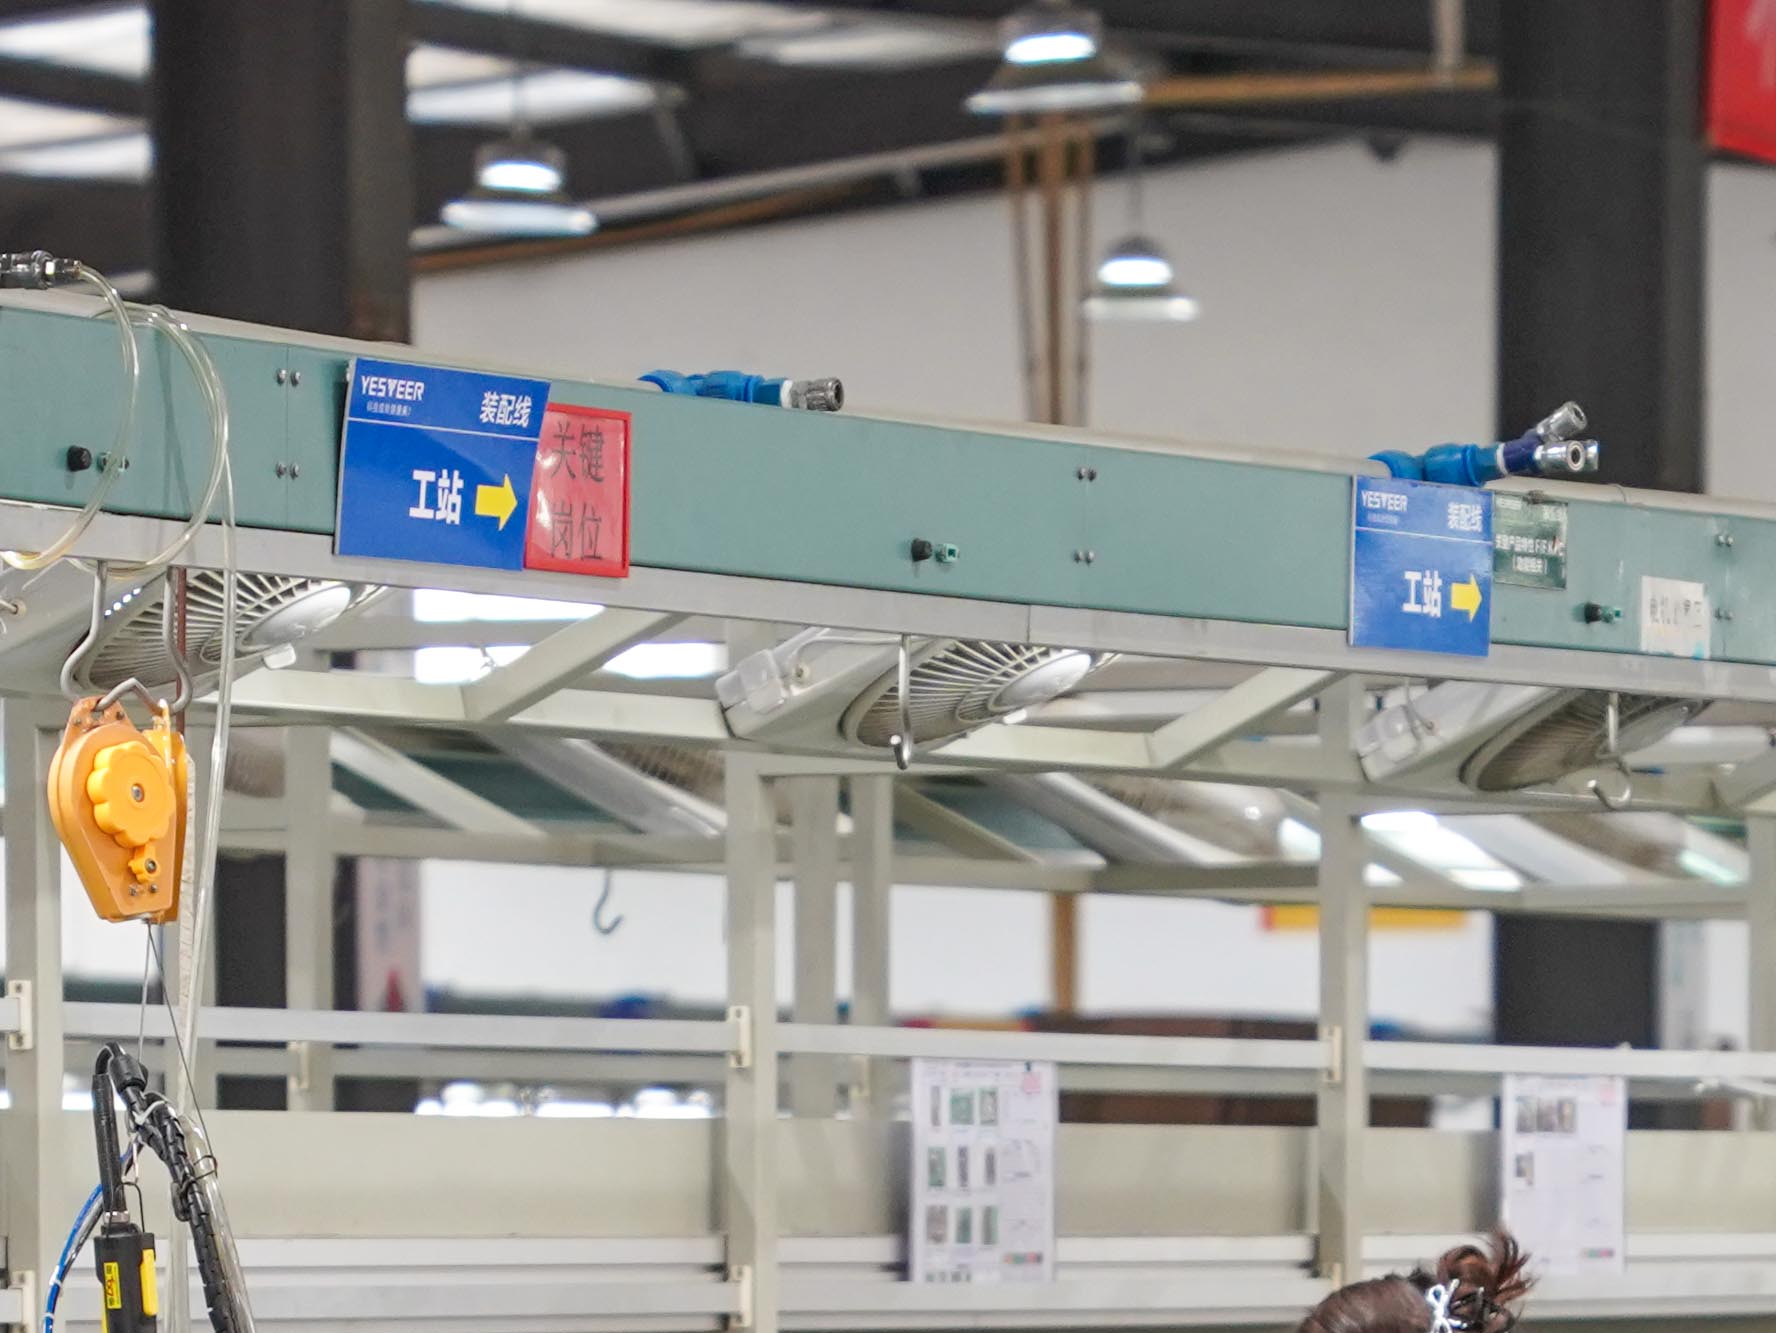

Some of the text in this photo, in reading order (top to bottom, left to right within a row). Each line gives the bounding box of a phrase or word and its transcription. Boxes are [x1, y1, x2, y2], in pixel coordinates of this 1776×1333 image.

[479, 390, 532, 428] 装配线
[409, 469, 464, 525] 工站
[1402, 569, 1443, 618] 工站
